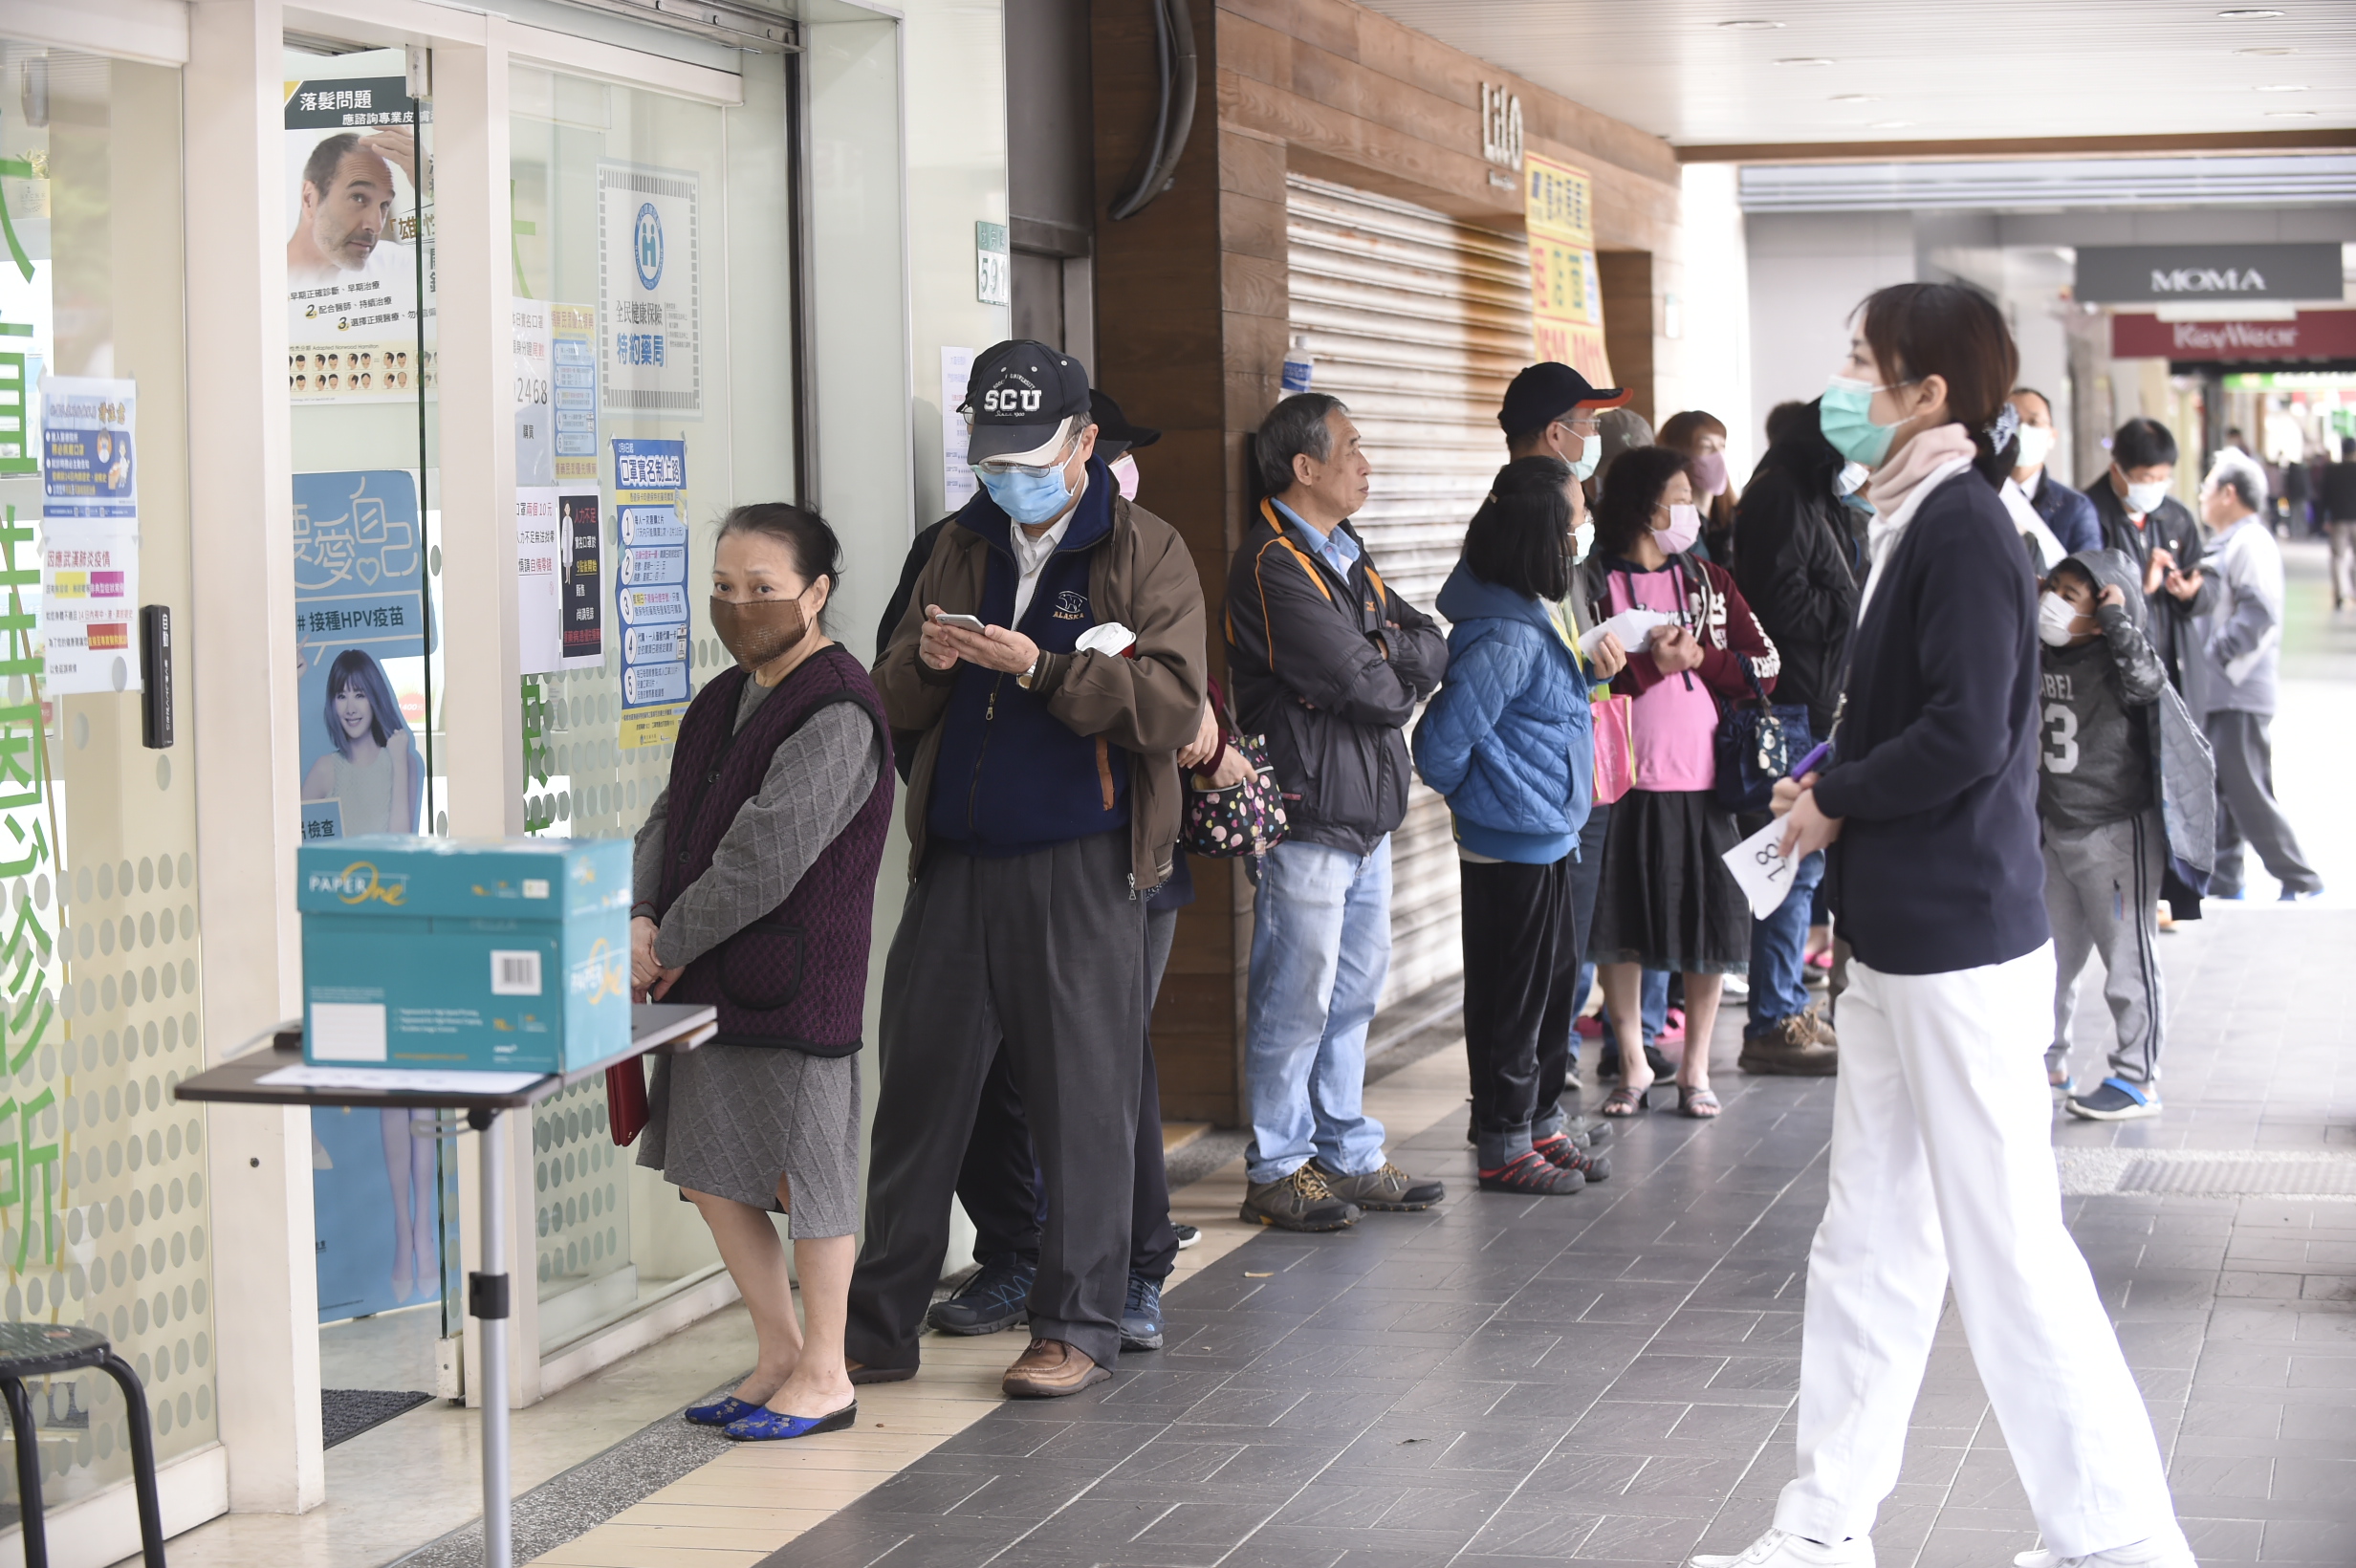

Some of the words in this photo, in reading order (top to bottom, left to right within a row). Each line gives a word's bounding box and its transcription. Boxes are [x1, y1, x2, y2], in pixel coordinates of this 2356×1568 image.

[300, 90, 372, 112] 落髮問題
[342, 111, 433, 126] 應諮詢專業皮膚
[2150, 267, 2266, 292] MOMA
[616, 300, 664, 326] 全民健康保險
[617, 333, 665, 368] 特約藥局
[514, 378, 548, 405] 2468
[984, 389, 1042, 412] SCU
[621, 458, 680, 484] 口罩實名制上路
[575, 508, 597, 524] 人力不足
[48, 551, 111, 568] 因應武漢肺炎疫情
[309, 606, 404, 632] 接種HPV疫苗
[1052, 610, 1085, 621] ALASKA
[309, 874, 367, 894] PAPER
